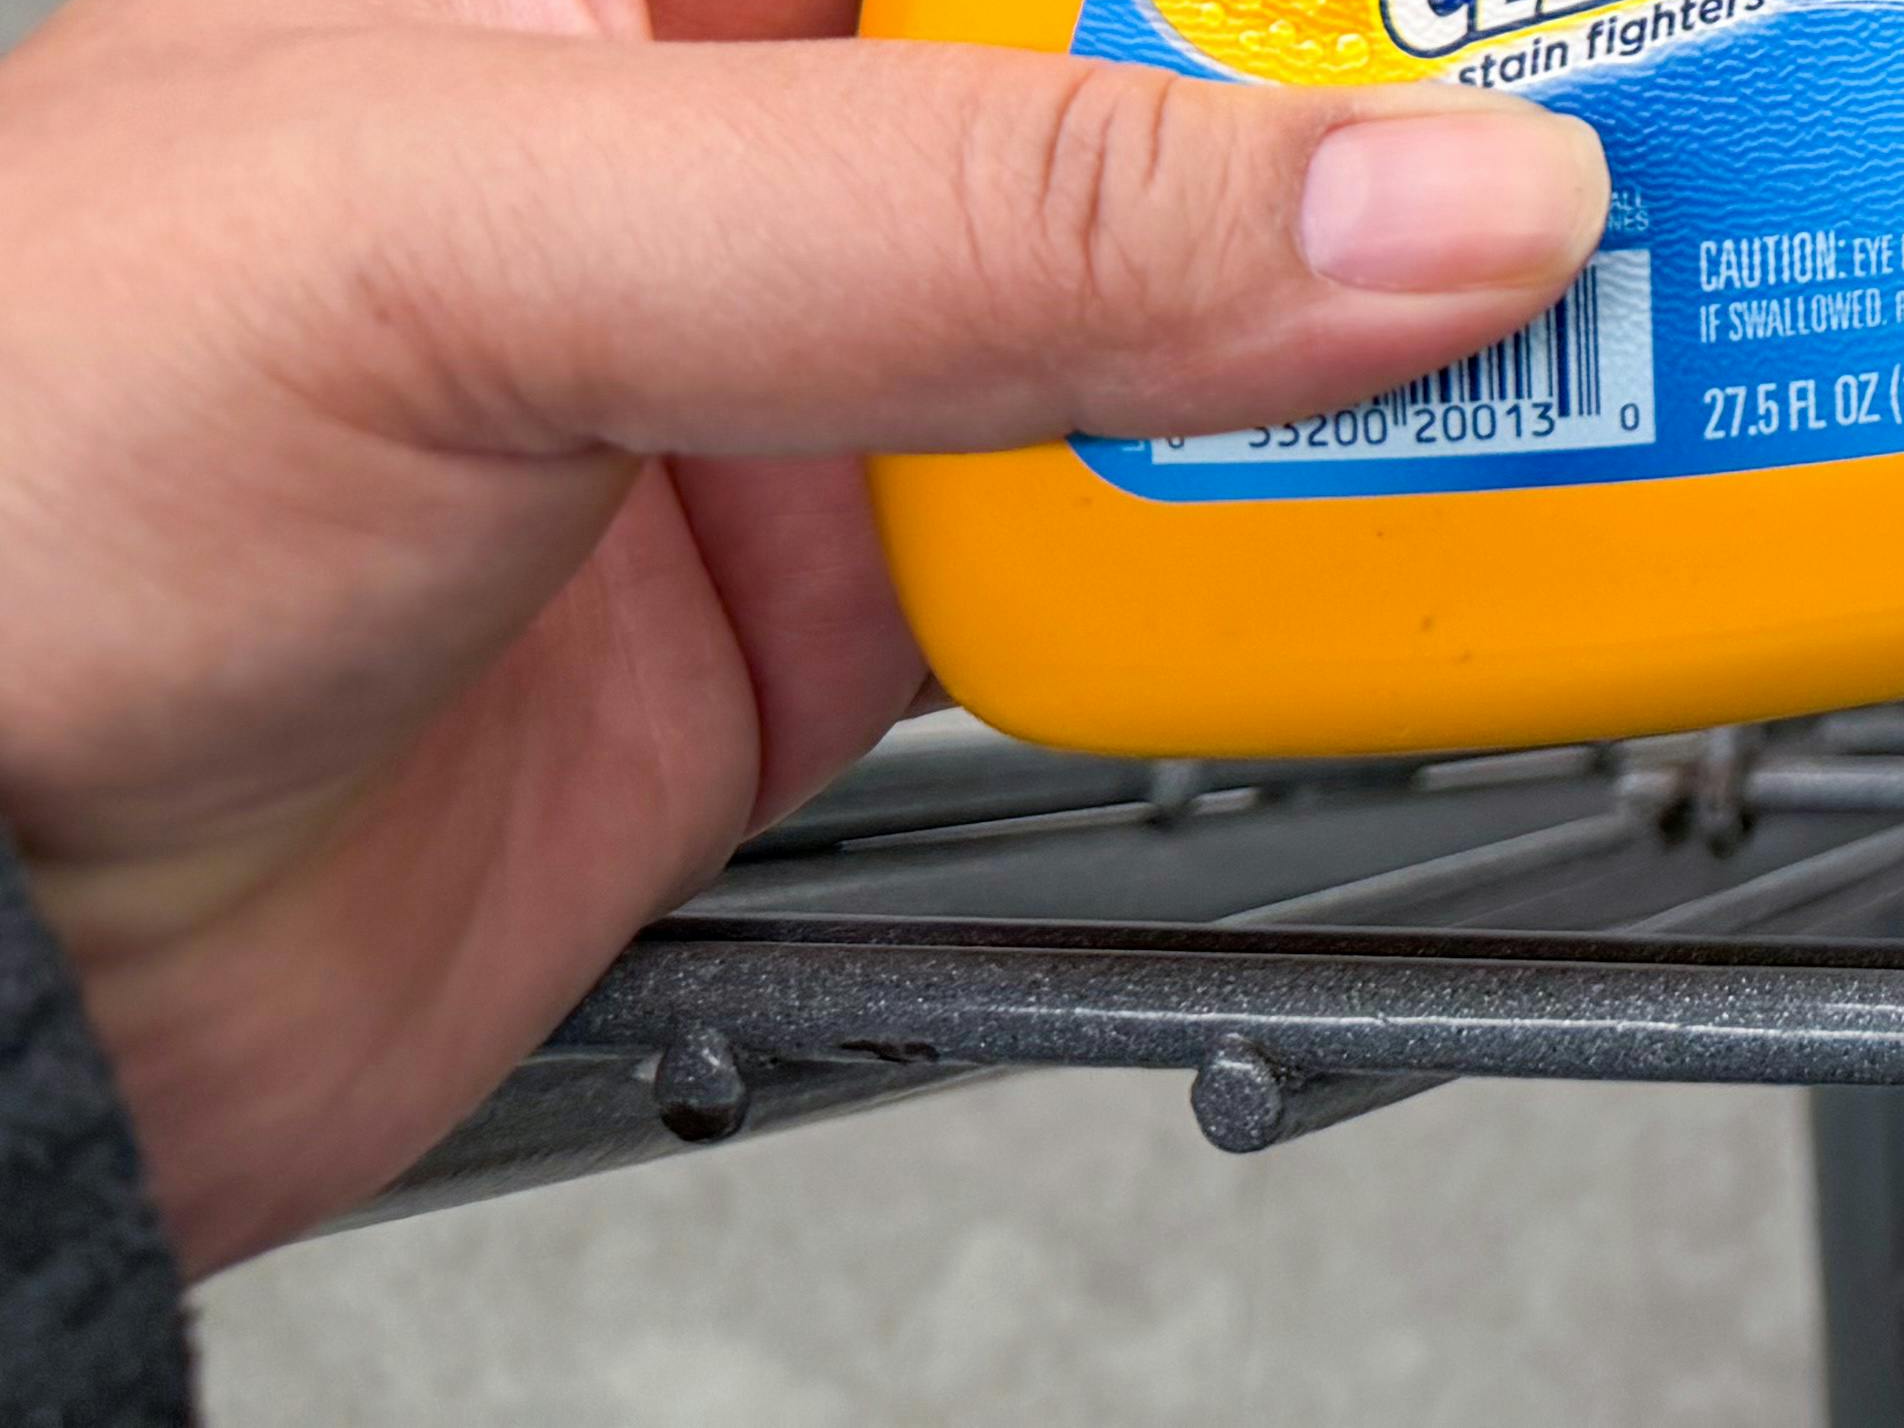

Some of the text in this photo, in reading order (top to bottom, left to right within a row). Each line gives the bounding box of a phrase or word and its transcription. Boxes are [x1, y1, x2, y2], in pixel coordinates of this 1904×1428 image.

[1457, 34, 1569, 90] stain
[1699, 229, 1847, 293] CAUTION:
[1854, 234, 1893, 279] EYE
[1699, 303, 1722, 344] IF
[1729, 287, 1888, 343] SWALLOWED.
[1414, 402, 1556, 445] 20013
[1619, 402, 1641, 433] 0
[1702, 384, 1780, 442] 27.5
[1789, 380, 1826, 431] FL
[1834, 372, 1882, 426] OZ
